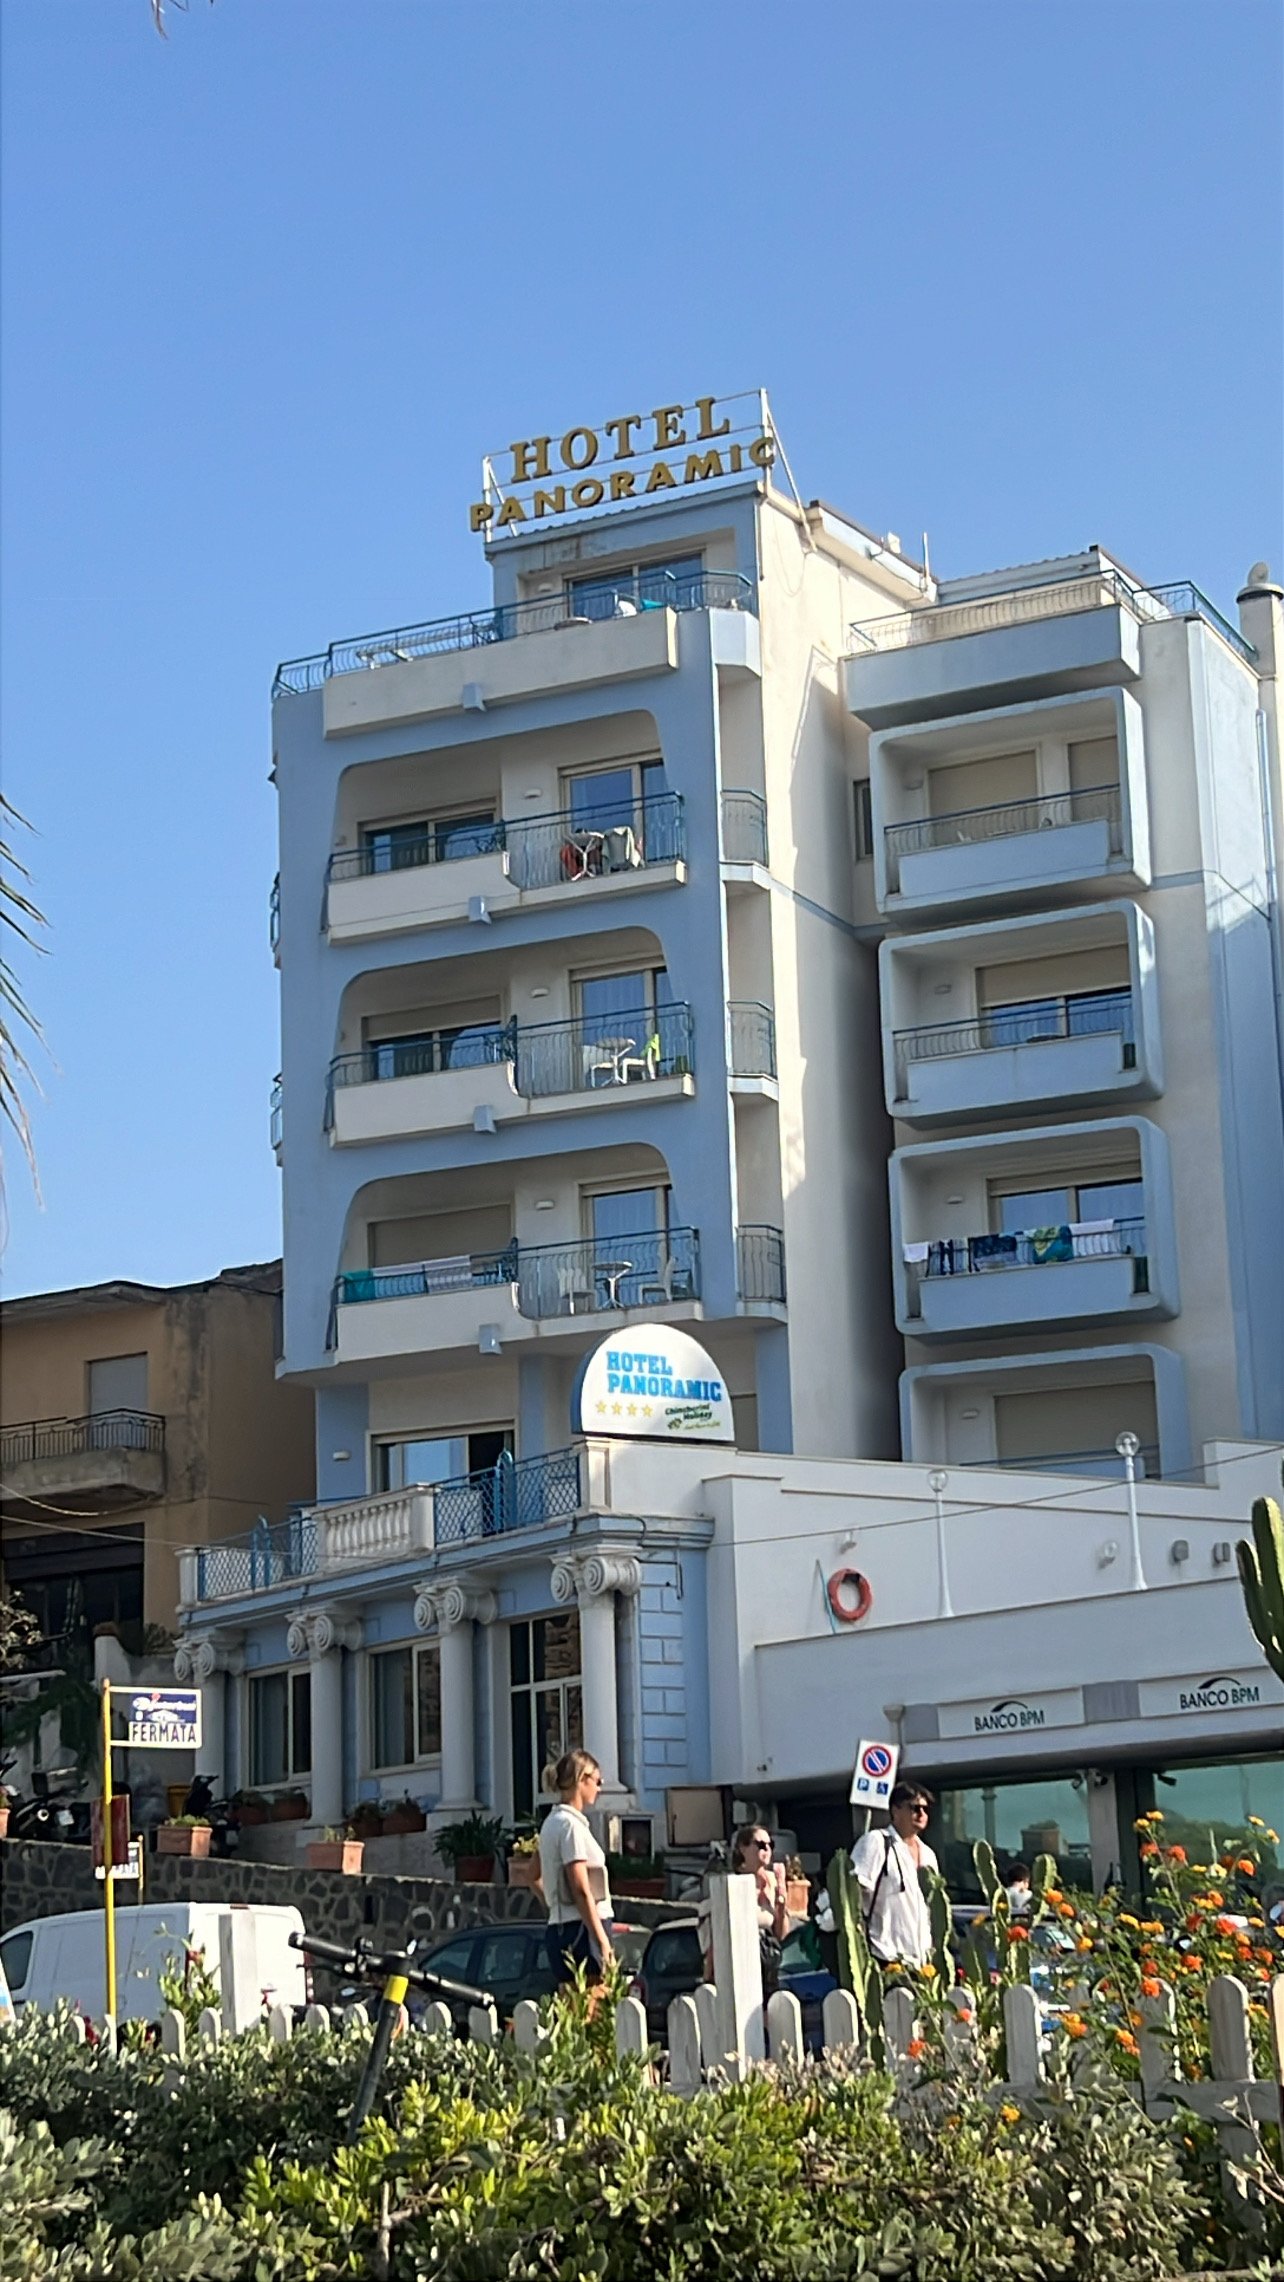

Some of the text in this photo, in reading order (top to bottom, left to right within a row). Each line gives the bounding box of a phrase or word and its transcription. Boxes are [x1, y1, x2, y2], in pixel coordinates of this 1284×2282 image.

[510, 396, 730, 484] HOTEL
[469, 436, 776, 533] PANORAMIC
[606, 1351, 673, 1376] HOTEL
[607, 1373, 722, 1402] PANORAMIC
[1180, 1686, 1260, 1709] BANCO BPM
[132, 1723, 197, 1743] FERMATA
[974, 1710, 1045, 1731] BANCO BPM
